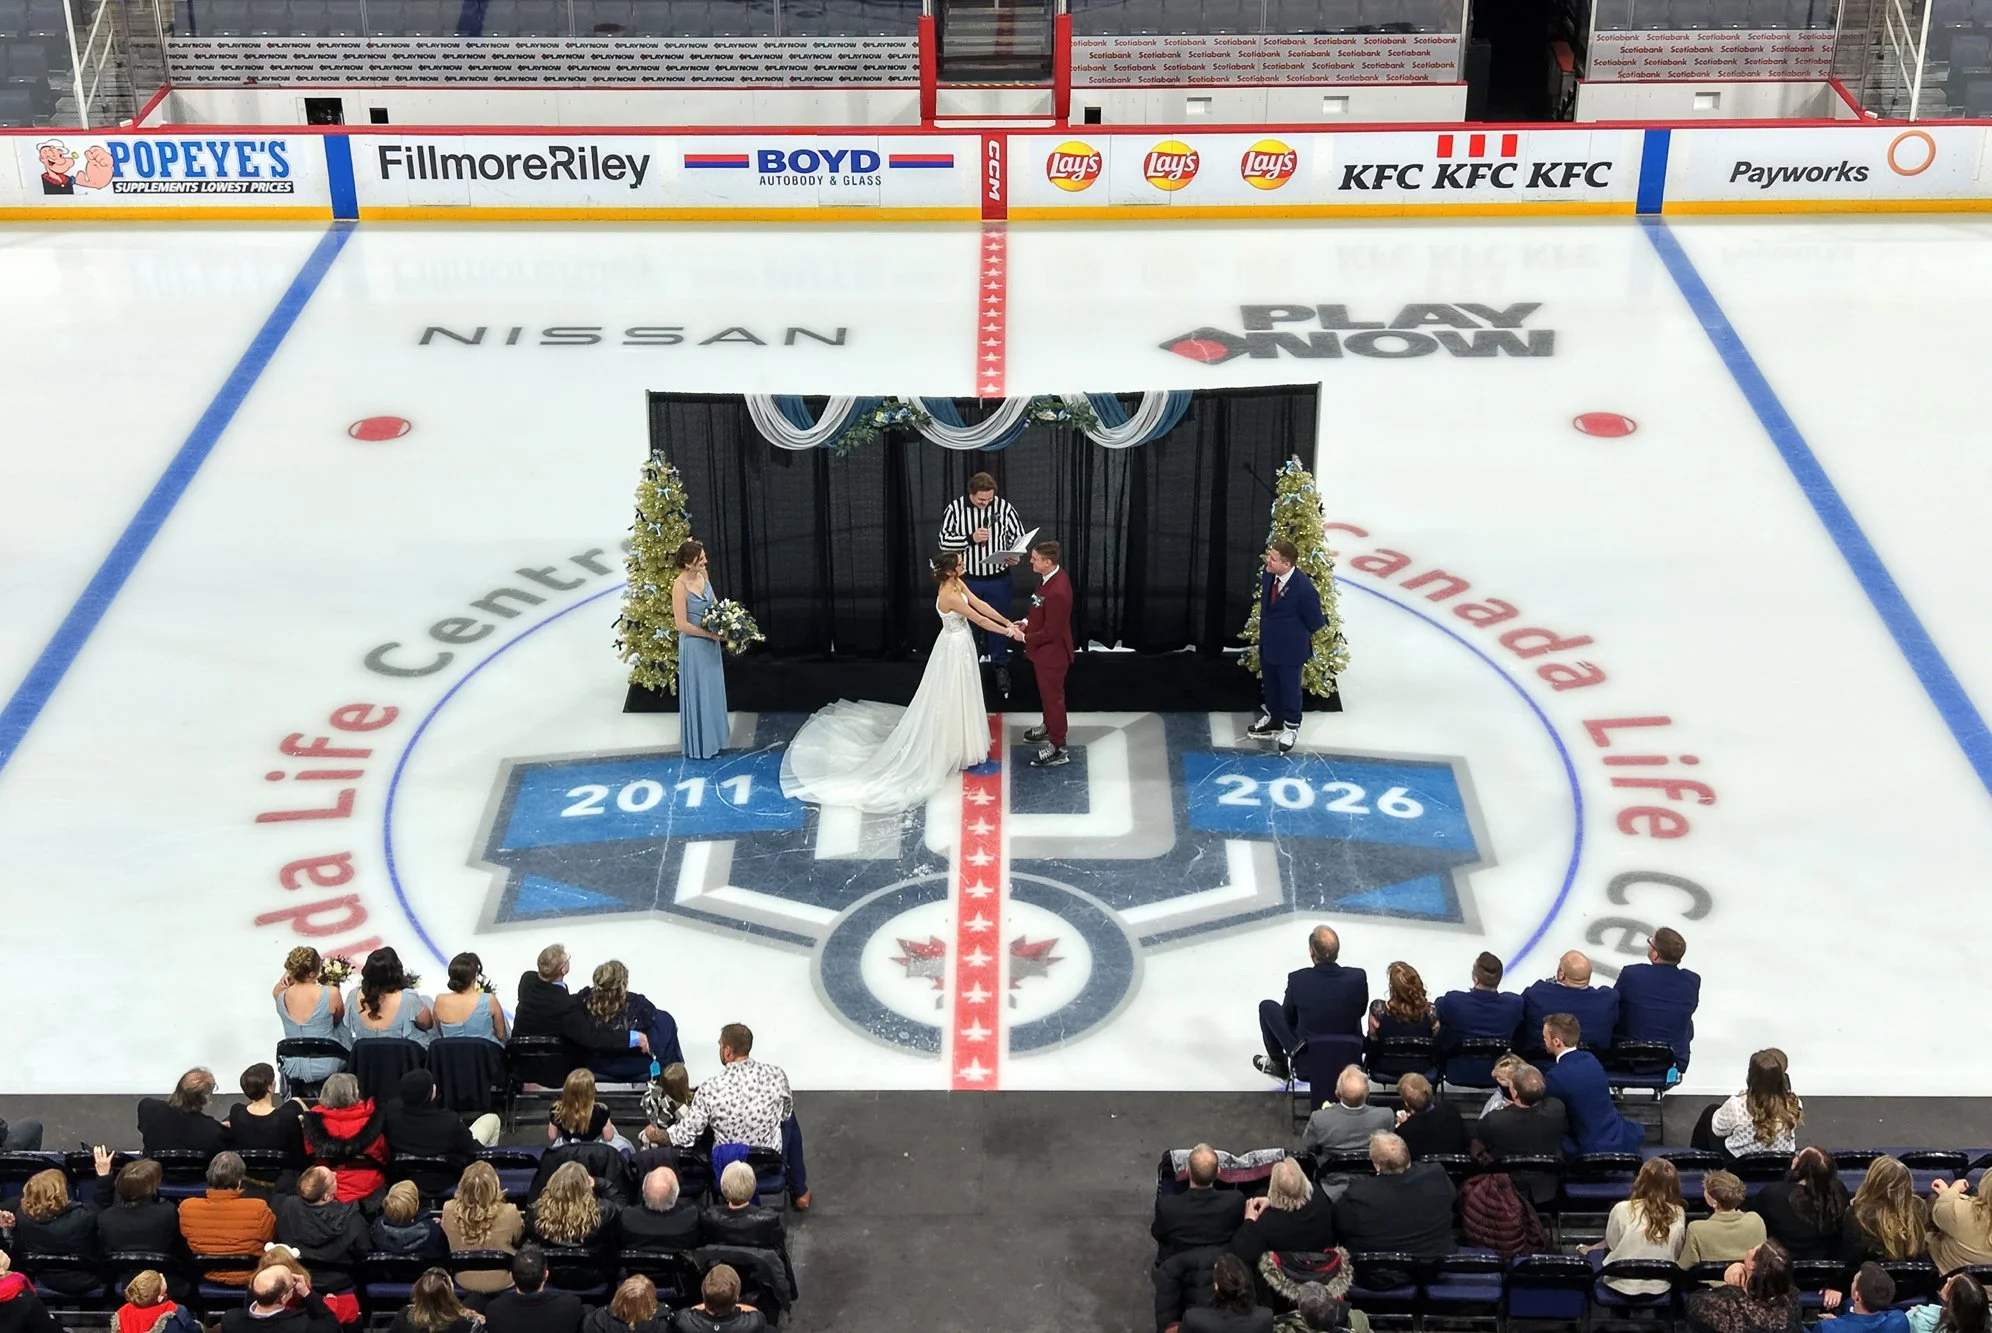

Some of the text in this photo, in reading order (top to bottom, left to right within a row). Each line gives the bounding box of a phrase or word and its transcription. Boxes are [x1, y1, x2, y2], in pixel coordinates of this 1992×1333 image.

[1071, 37, 1457, 48] cotiabank Scotiabank Scotiabank Scotiabank Scotiabank Scotiabank Scotiabank Scotiabank
[1620, 46, 1663, 54] Scotiabank
[1671, 46, 1714, 54] Scotiabank
[1771, 45, 1814, 53] Scotiabank
[1697, 33, 1740, 41] Scotiabank
[1070, 64, 1106, 72] cotiabank
[1164, 63, 1206, 71] Scotiabank
[1213, 63, 1255, 71] Scotiabank
[1312, 62, 1355, 70] Scotiabank
[1362, 62, 1405, 70] Scotiabank
[1089, 51, 1132, 59] Scotiabank
[1137, 51, 1181, 59] Scotiabank
[1238, 50, 1280, 58] Scotiabank
[1288, 50, 1330, 58] Scotiabank
[1388, 49, 1431, 57] Scotiabank
[1644, 58, 1687, 66] Scotiabank
[1089, 76, 1131, 84] Scotiabank
[1138, 76, 1181, 84] Scotiabank
[1237, 75, 1279, 83] Scotiabank
[1287, 75, 1330, 83] Scotiabank
[1386, 74, 1429, 82] Scotiabank
[1718, 70, 1760, 78] Scotiabank
[106, 140, 290, 178] POPEYE'S
[378, 145, 650, 189] FillmoreRiley
[757, 149, 881, 173] BOYD
[988, 139, 1000, 201] CCM
[1050, 152, 1099, 181] Lay's
[1147, 151, 1196, 180] Lay's
[1244, 150, 1293, 180] Lay's
[114, 181, 292, 194] SUPPLEMENTS LOWEST PRICES
[759, 175, 882, 186] AUTOBODY & GLASS
[1338, 162, 1612, 190] KFC KFC KFC
[1729, 160, 1870, 189] Payworks
[1239, 302, 1543, 330] PLAY
[418, 326, 848, 346] NISSAN
[1244, 329, 1555, 359] NOW
[255, 703, 399, 823] Life
[364, 541, 632, 678] Centr
[1582, 715, 1716, 839] Life
[560, 774, 753, 818] 2011
[1215, 773, 1424, 819] 2026
